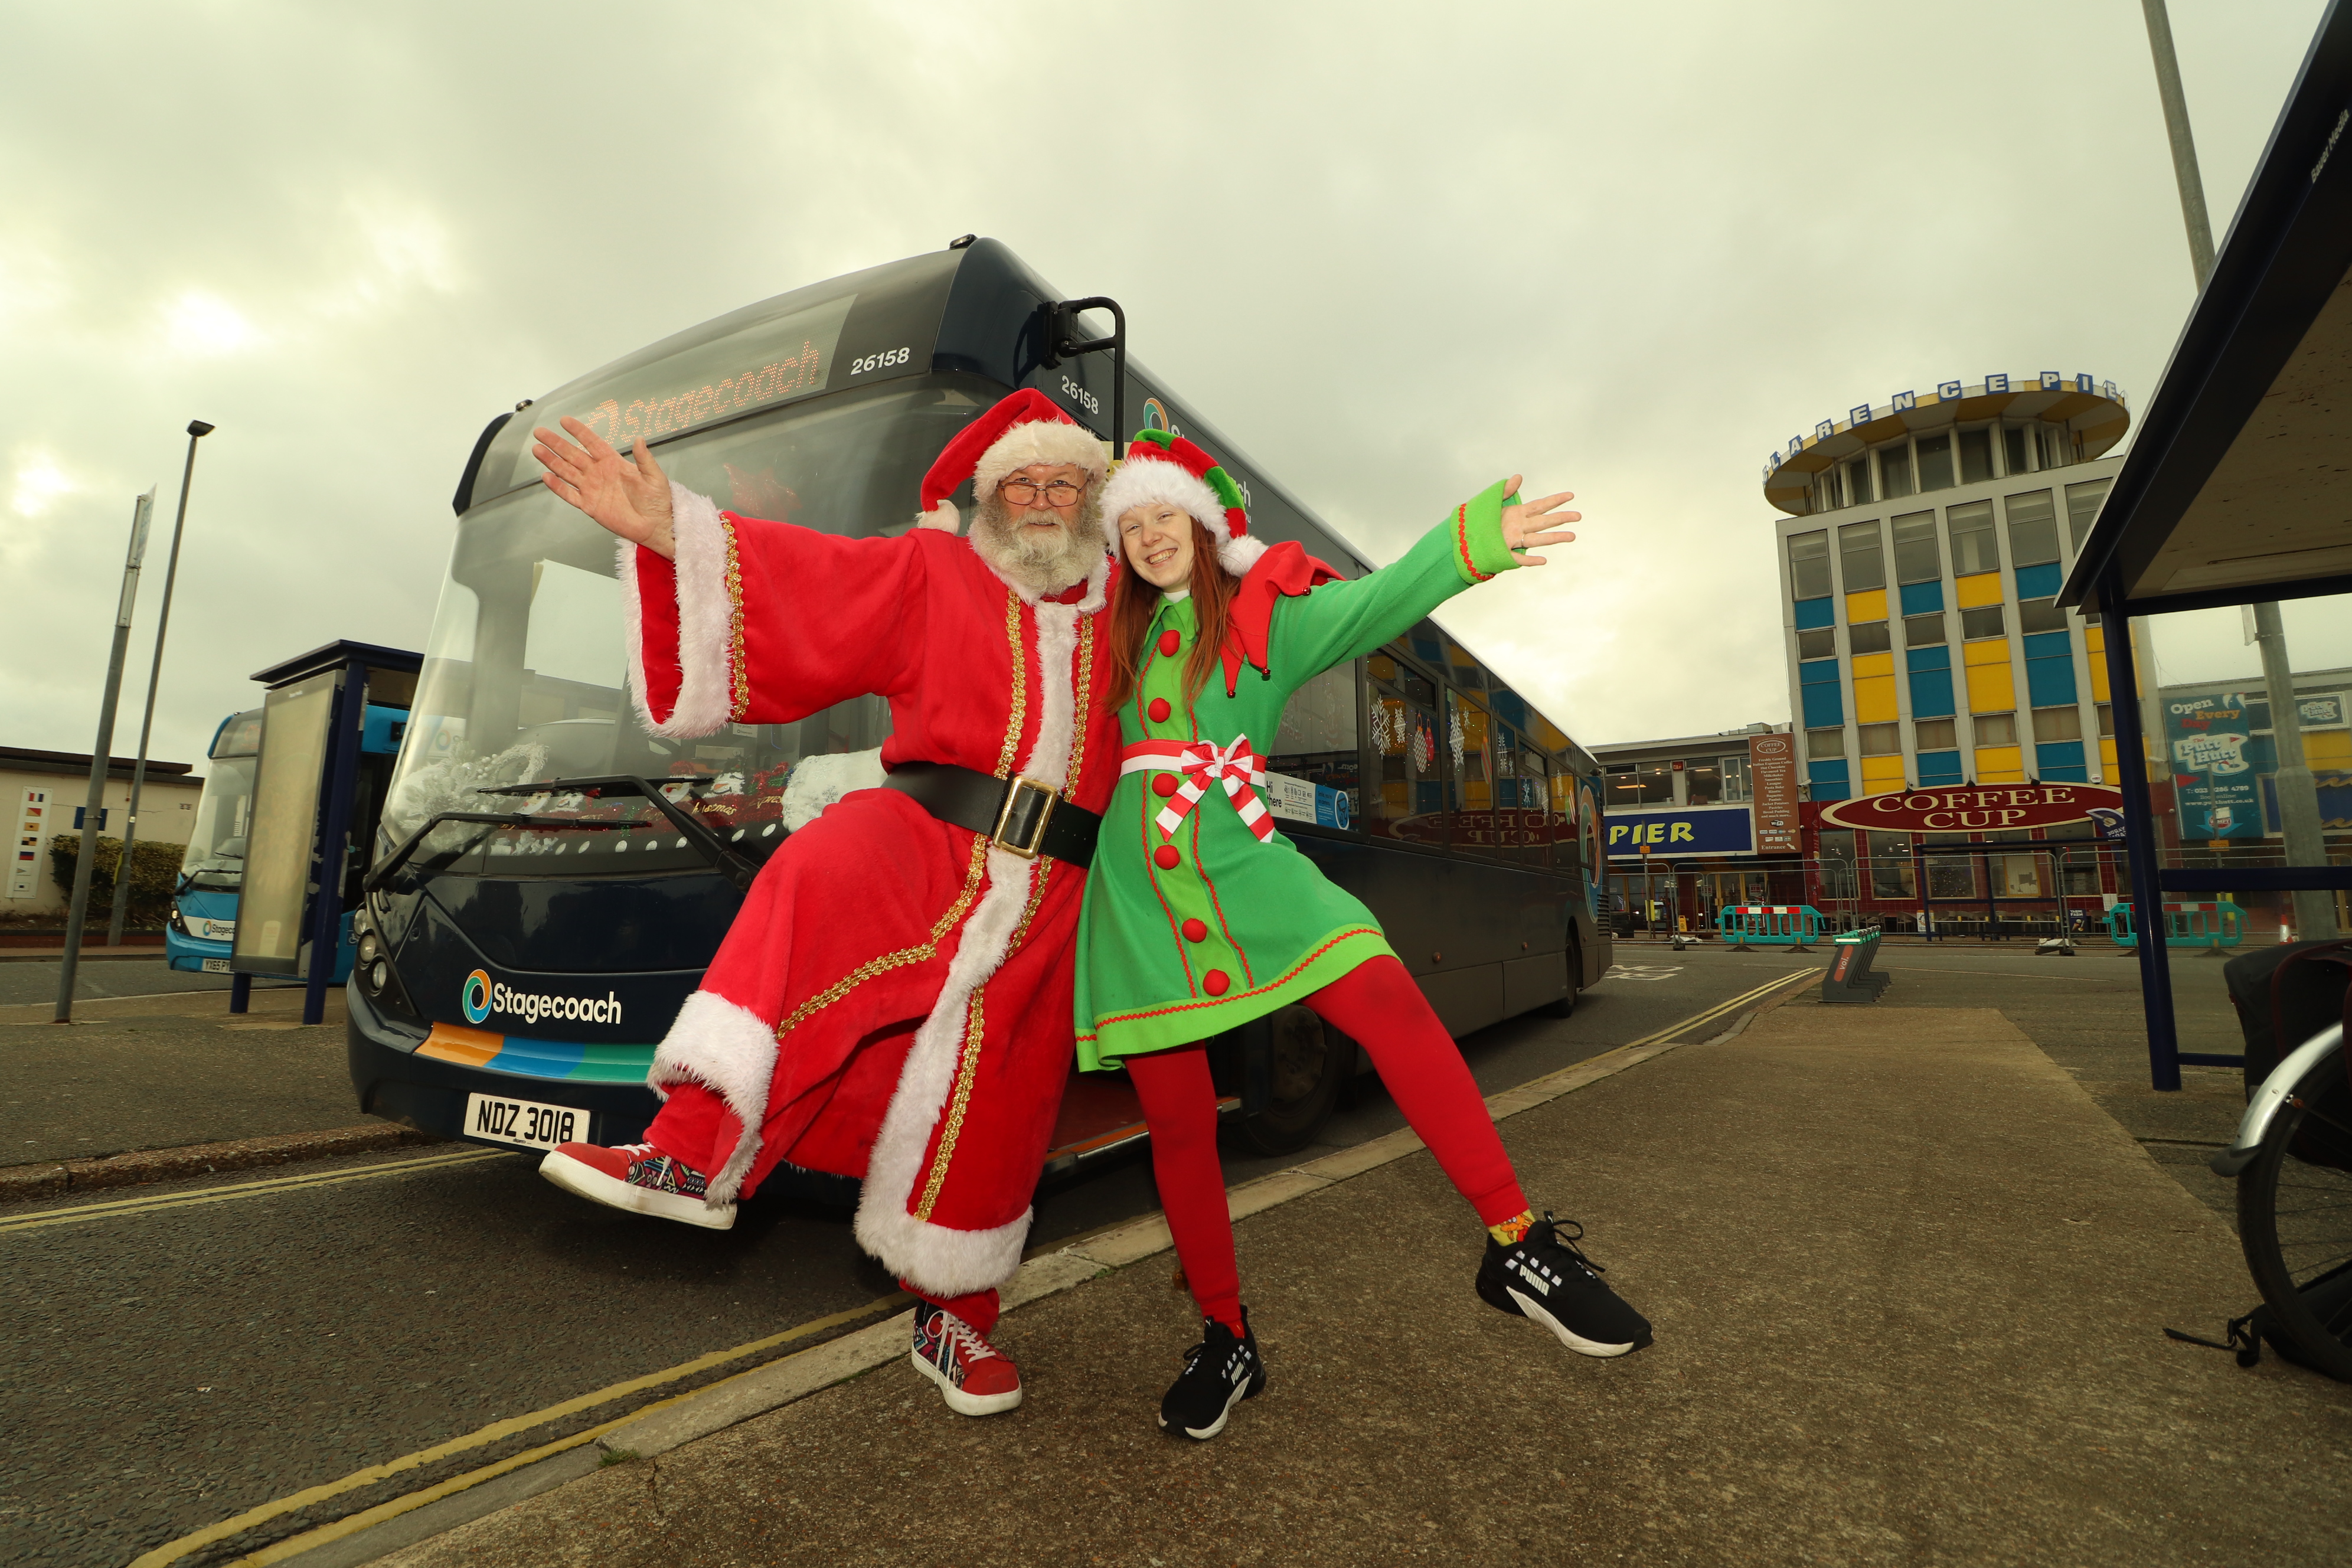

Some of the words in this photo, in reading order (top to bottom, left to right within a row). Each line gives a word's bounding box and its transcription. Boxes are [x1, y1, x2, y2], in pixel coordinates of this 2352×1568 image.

[2311, 145, 2329, 184] Bauer
[2328, 109, 2349, 151] Media
[850, 347, 910, 375] 26158
[1061, 375, 1099, 414] 26158
[1762, 375, 2006, 482] CLARENCE
[2171, 699, 2214, 714] Open
[2195, 710, 2240, 720] Every
[2181, 718, 2211, 730] Day
[2181, 739, 2221, 755] Putt
[2195, 748, 2237, 765] Hutt
[1266, 780, 1273, 793] Hi
[1267, 794, 1282, 808] there
[1873, 787, 2075, 812] COFFEE
[1923, 809, 2026, 828] CUP
[1609, 822, 1695, 845] PIER
[1840, 956, 1849, 970] voi.
[492, 982, 622, 1024] Stagecoach
[477, 1100, 520, 1137] NDZ
[524, 1107, 574, 1144] 3018
[1519, 1264, 1550, 1296] PUMA
